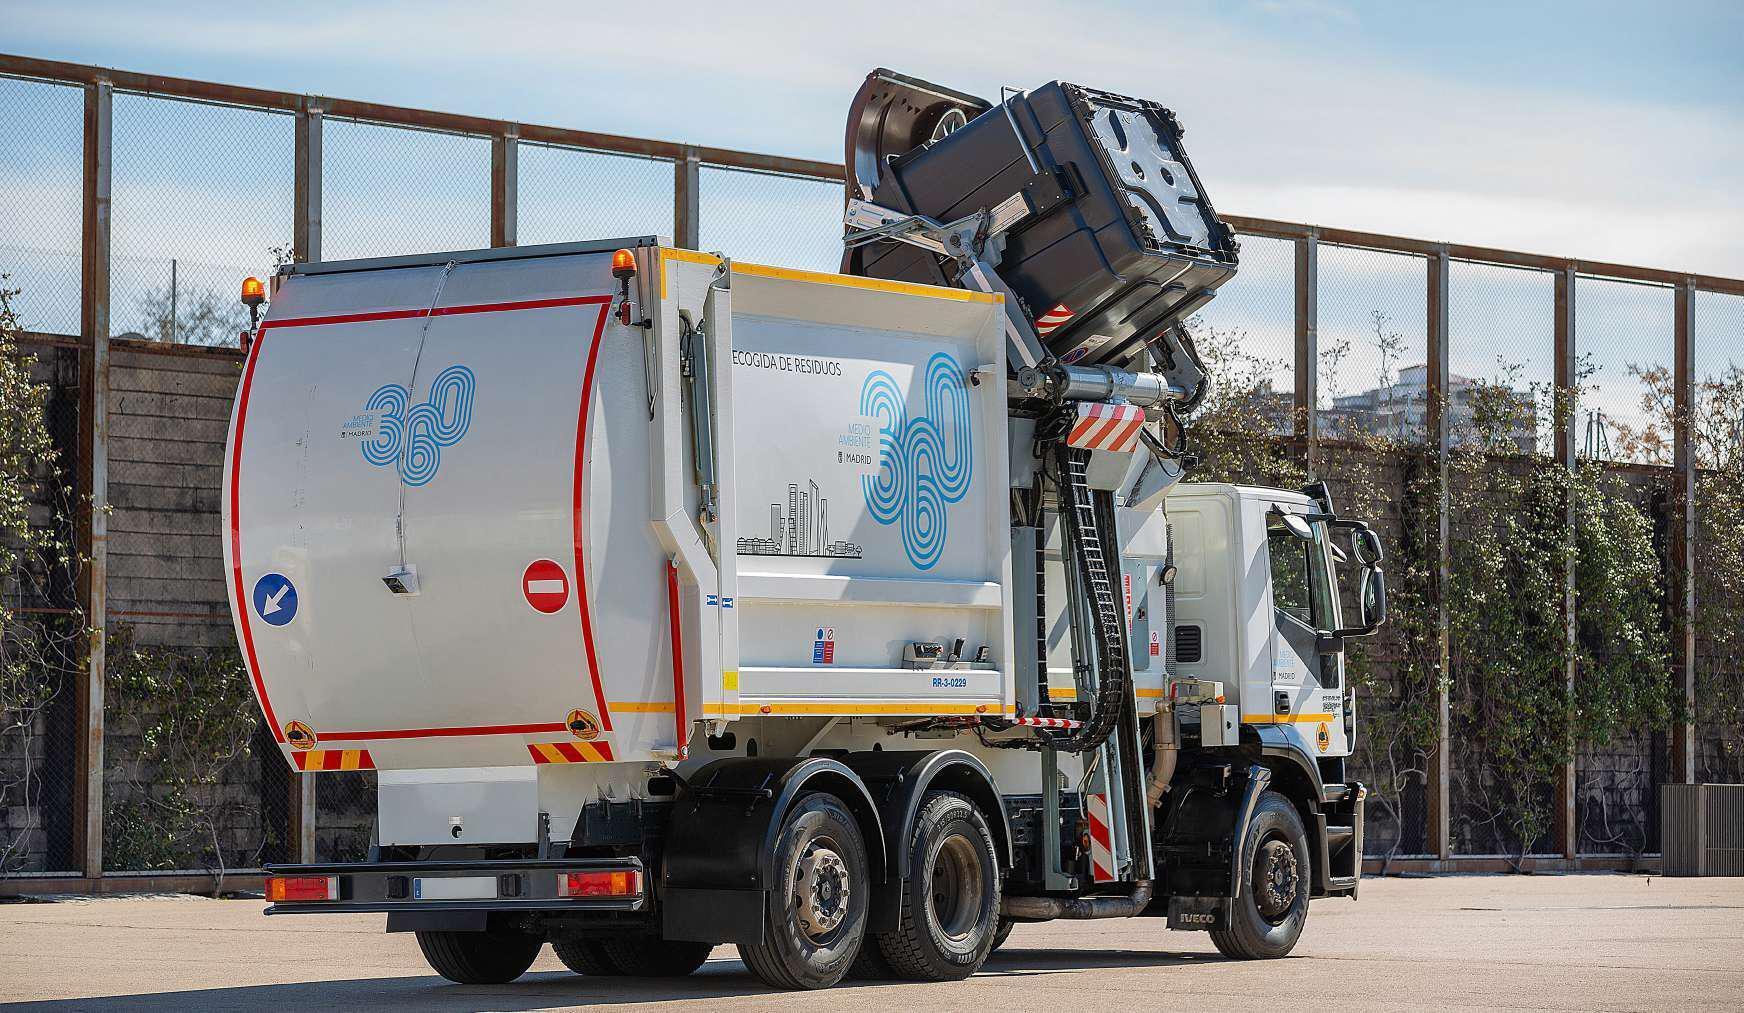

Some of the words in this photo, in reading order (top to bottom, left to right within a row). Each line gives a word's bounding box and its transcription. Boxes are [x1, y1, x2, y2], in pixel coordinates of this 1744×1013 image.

[732, 350, 777, 370] ECOGIDA
[779, 356, 793, 371] DE
[795, 358, 842, 376] RESIDUOS
[848, 423, 871, 436] MEDIO
[838, 433, 872, 448] AMBIENTE
[846, 452, 872, 465] MADRID
[932, 677, 967, 687] RR-3-0229
[1180, 913, 1216, 924] IVECO
